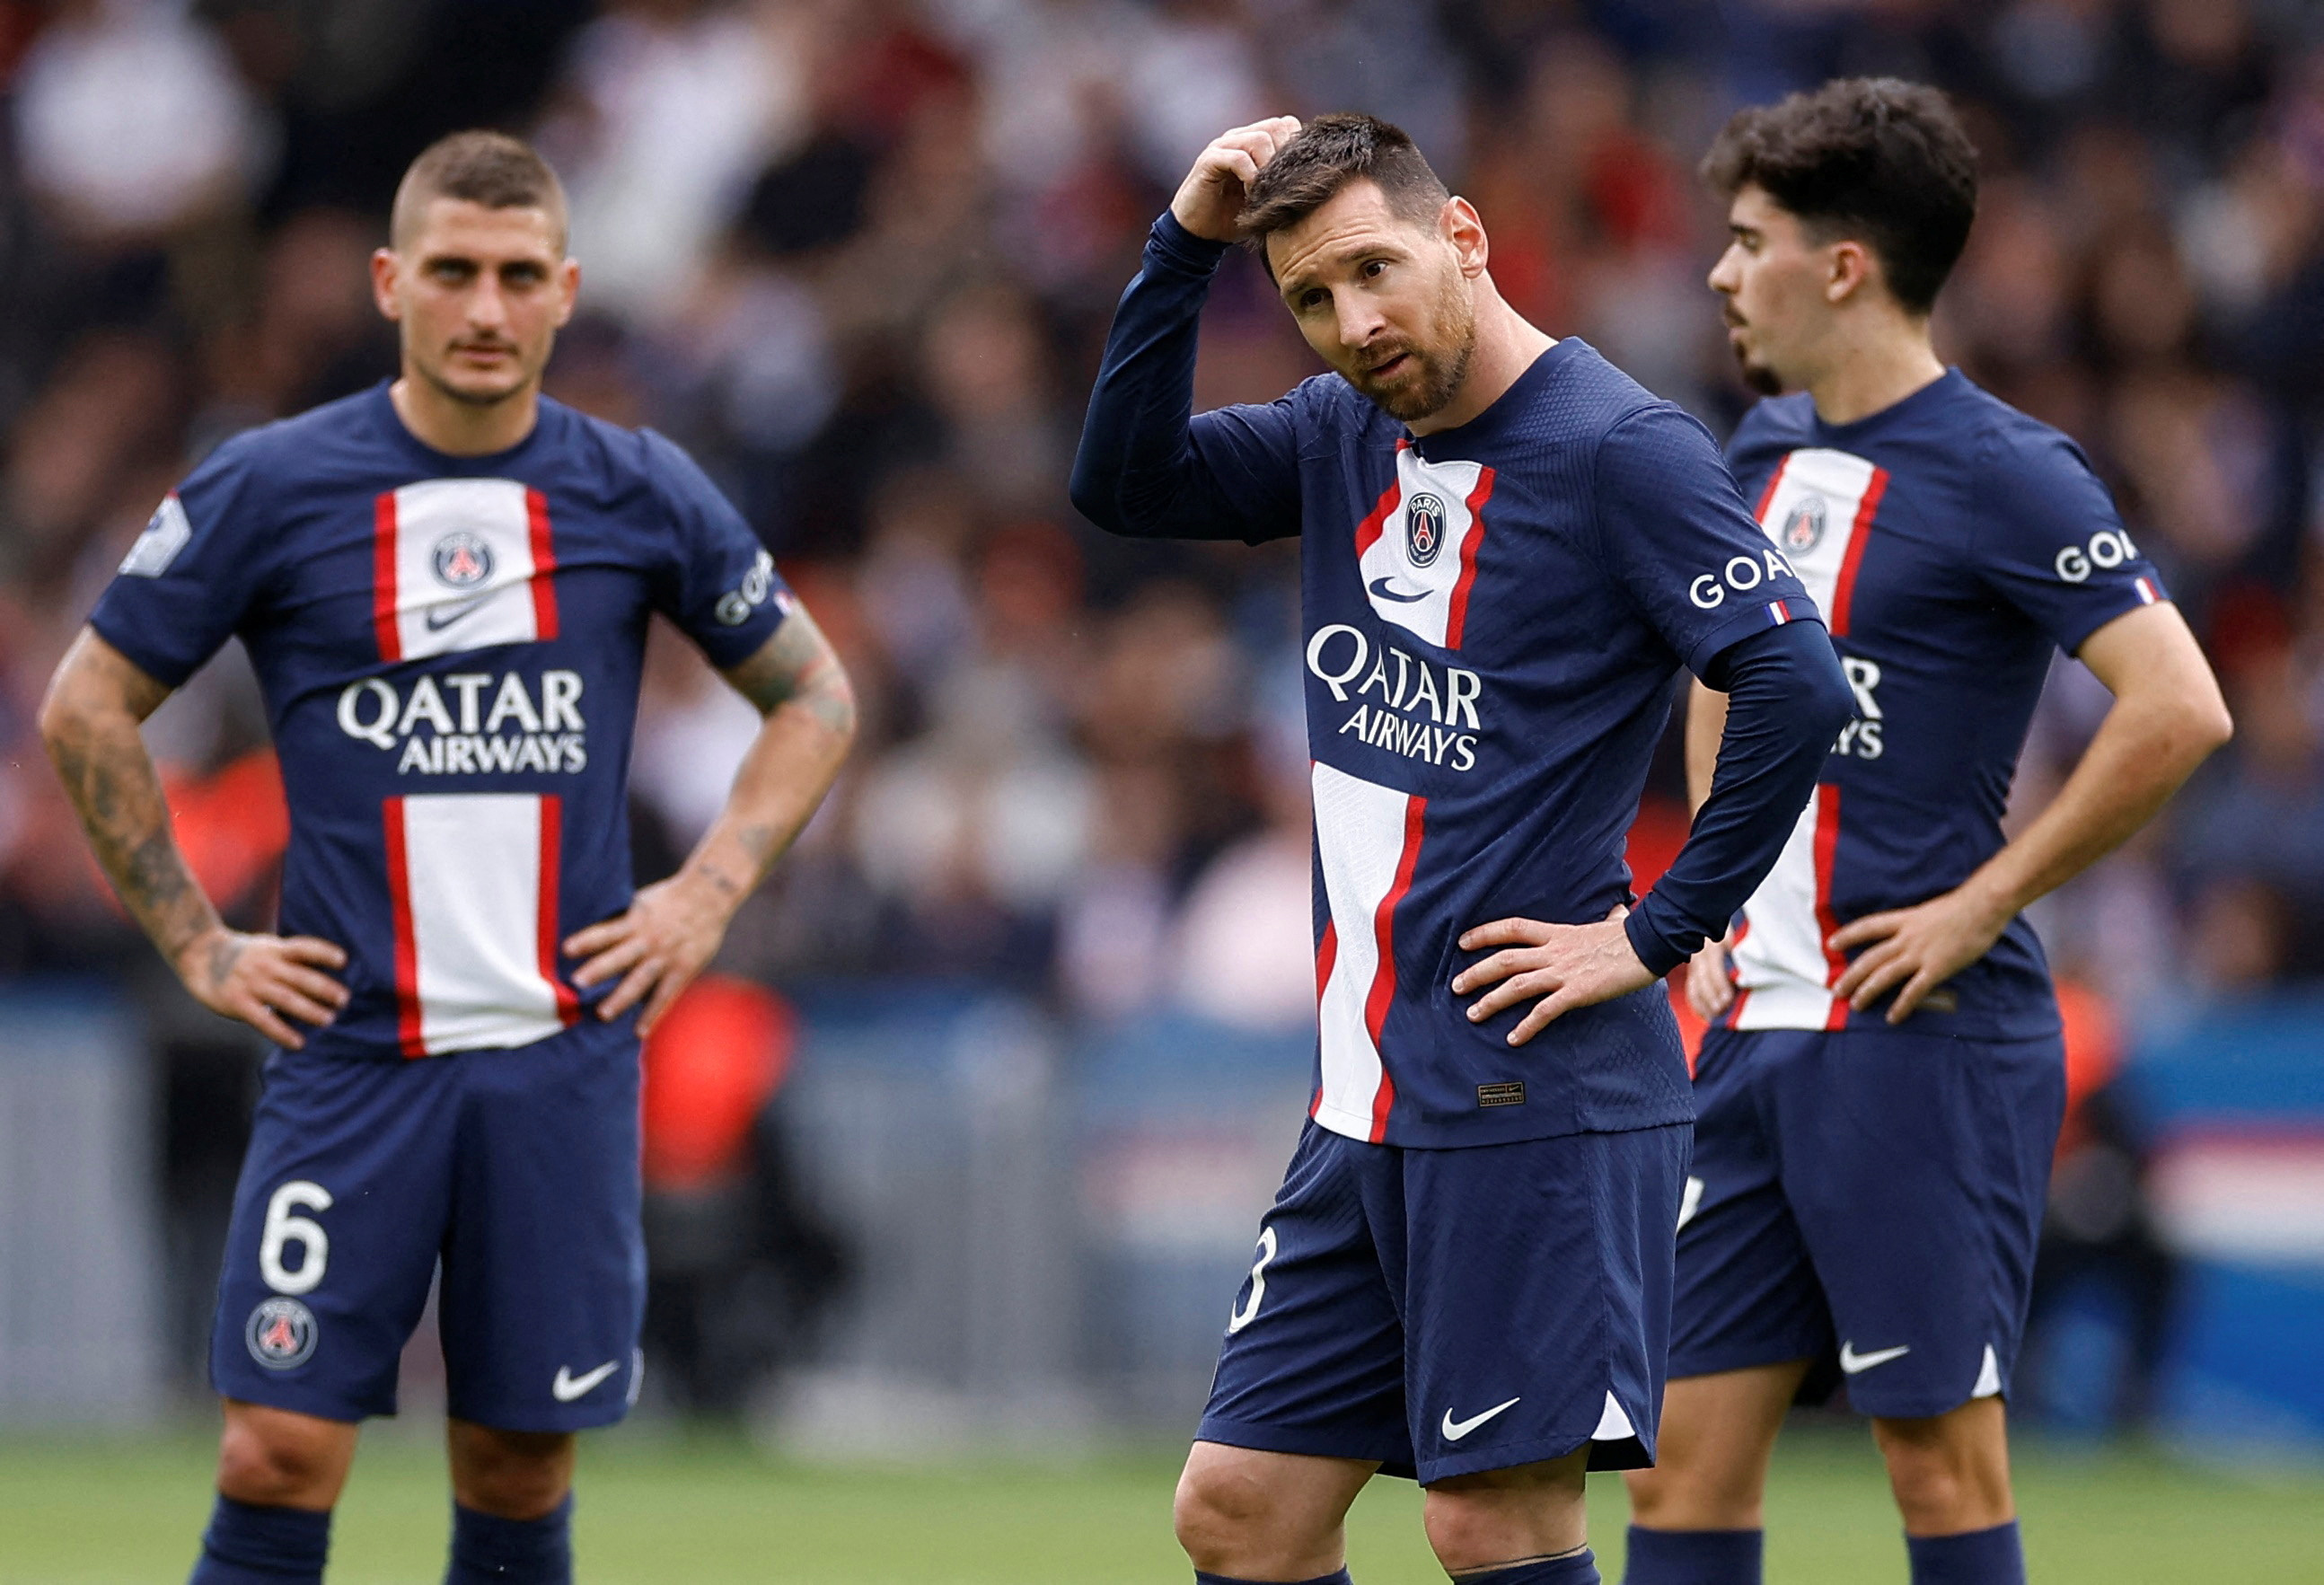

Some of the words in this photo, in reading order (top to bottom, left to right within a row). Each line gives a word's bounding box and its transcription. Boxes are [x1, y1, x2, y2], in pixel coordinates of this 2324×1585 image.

[1411, 498, 1440, 517] PARIS
[337, 669, 586, 750] QATAR
[1307, 624, 1482, 730] QATAR
[398, 733, 586, 774] AIRWAYS
[1339, 704, 1478, 771] AIRWAYS
[260, 1180, 334, 1296] 6
